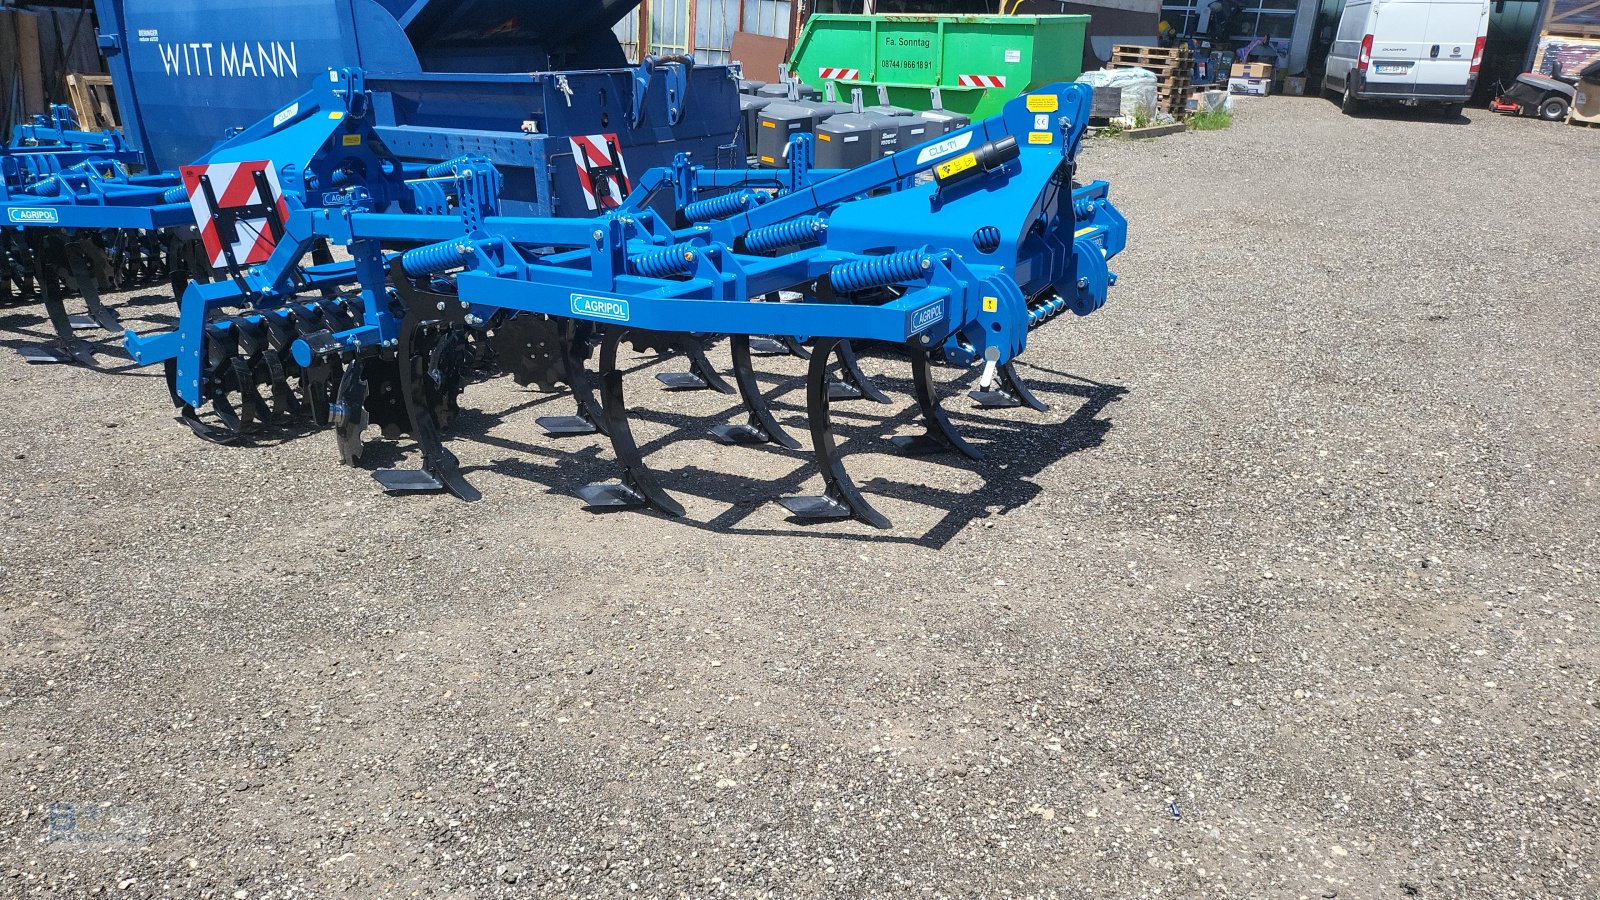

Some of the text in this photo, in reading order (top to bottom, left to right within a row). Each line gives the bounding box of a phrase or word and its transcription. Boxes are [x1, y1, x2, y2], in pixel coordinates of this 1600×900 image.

[885, 37, 930, 49] Fa. Sonntag
[1036, 118, 1046, 126] CE
[928, 139, 957, 157] CULTI
[20, 210, 55, 219] AGRIPOL
[584, 299, 626, 316] AGRIPOL
[918, 304, 943, 325] AGRIPOL
